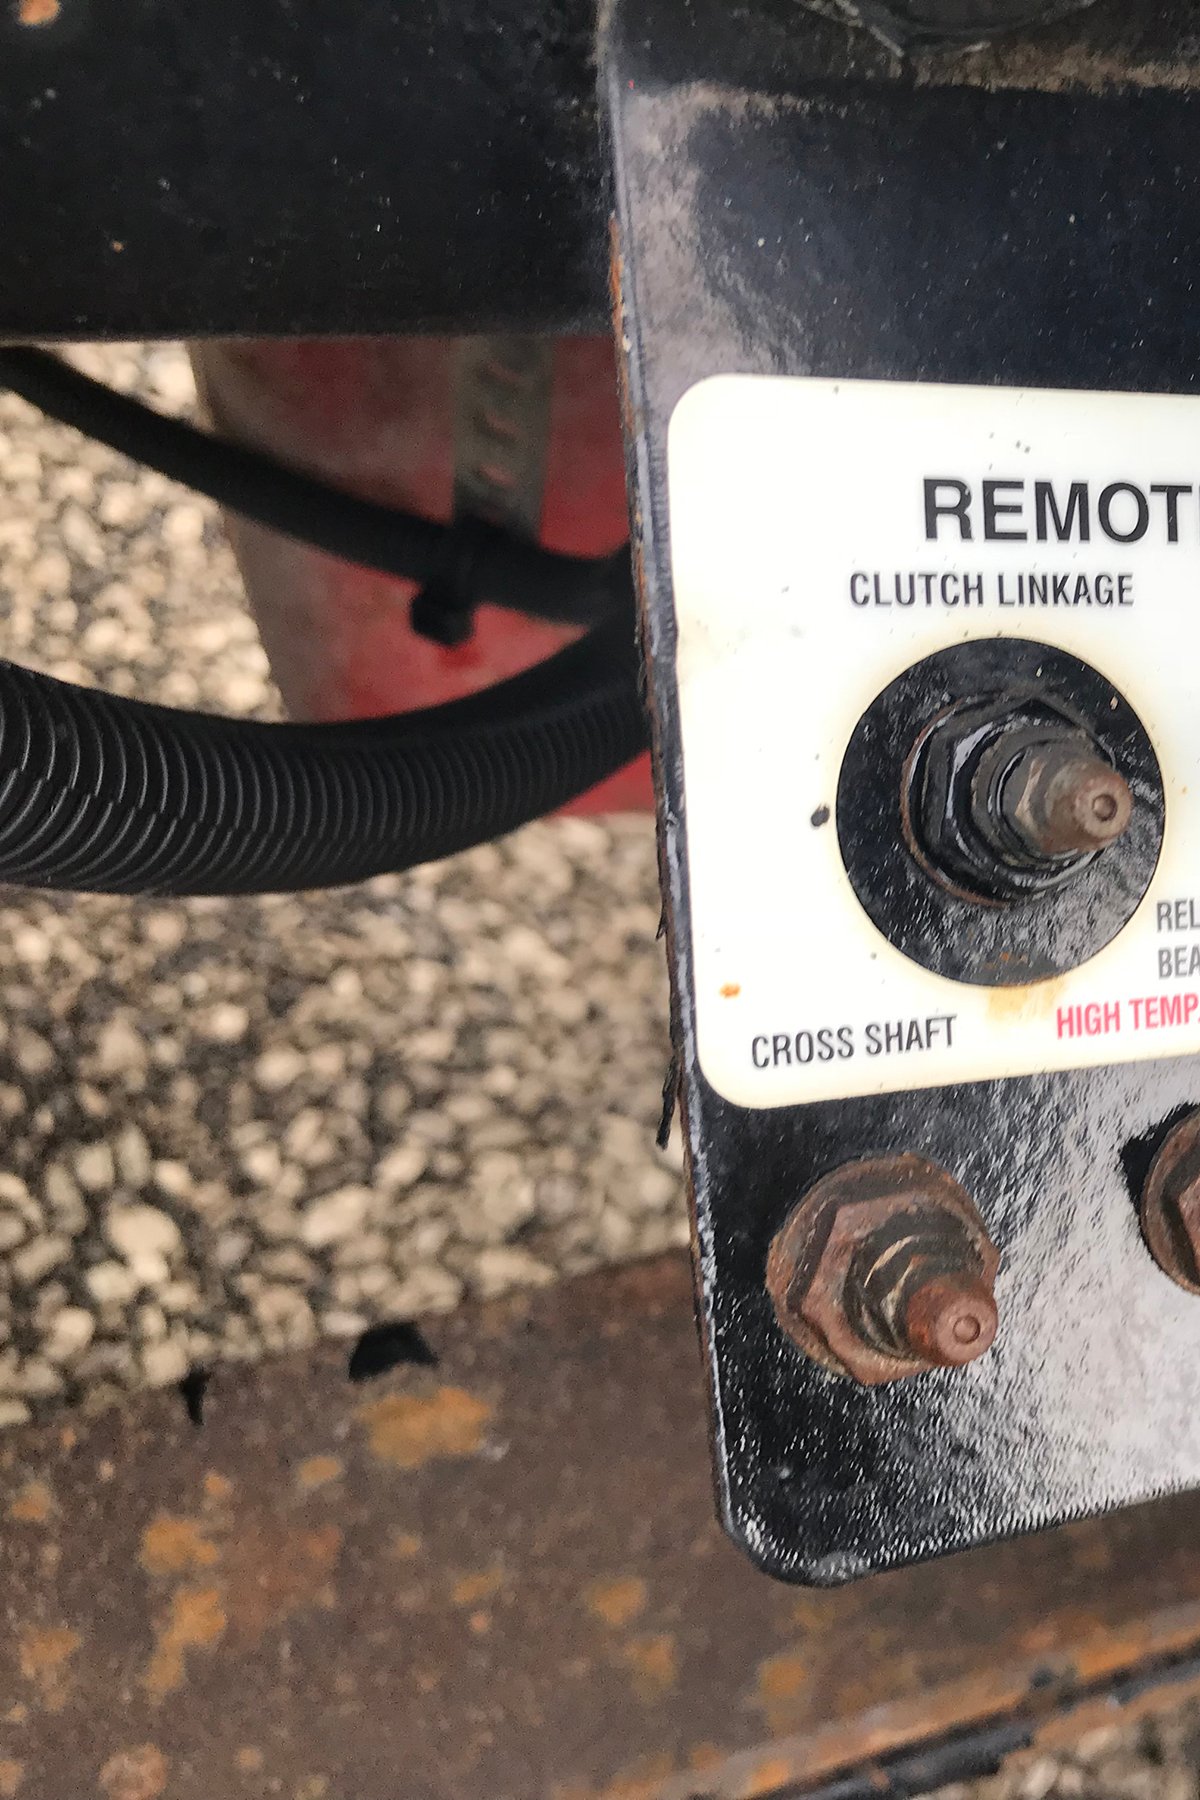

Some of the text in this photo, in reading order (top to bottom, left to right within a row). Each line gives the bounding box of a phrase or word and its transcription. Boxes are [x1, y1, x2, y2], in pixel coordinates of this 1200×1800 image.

[849, 571, 1134, 607] CLUTCH LINKAGE
[1056, 1001, 1121, 1038] HIGH
[751, 1015, 957, 1069] CROSS SHAFT
